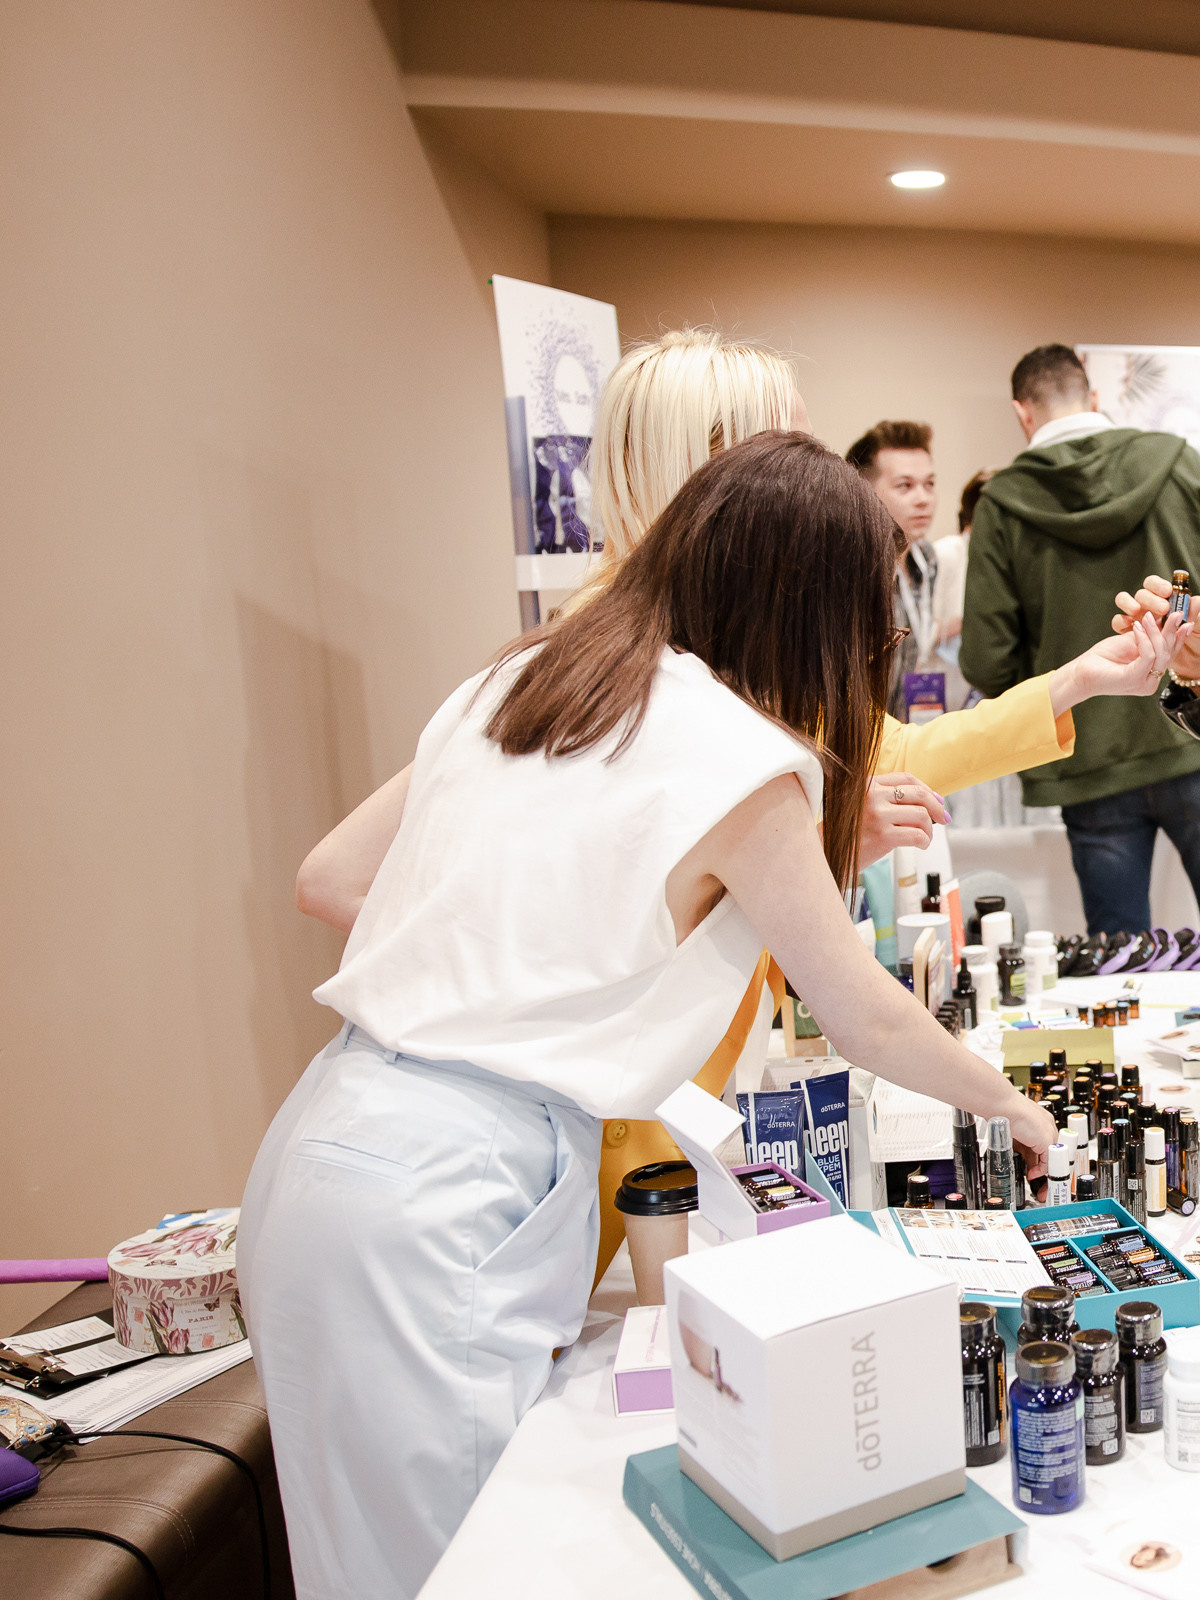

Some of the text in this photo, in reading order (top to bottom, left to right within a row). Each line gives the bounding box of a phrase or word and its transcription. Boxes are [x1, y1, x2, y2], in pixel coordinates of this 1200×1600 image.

[803, 1119, 849, 1157] deep
[745, 1139, 798, 1174] deep
[817, 1154, 840, 1167] BLUE
[188, 1315, 214, 1323] PARIS
[850, 1330, 882, 1472] dōTERRA
